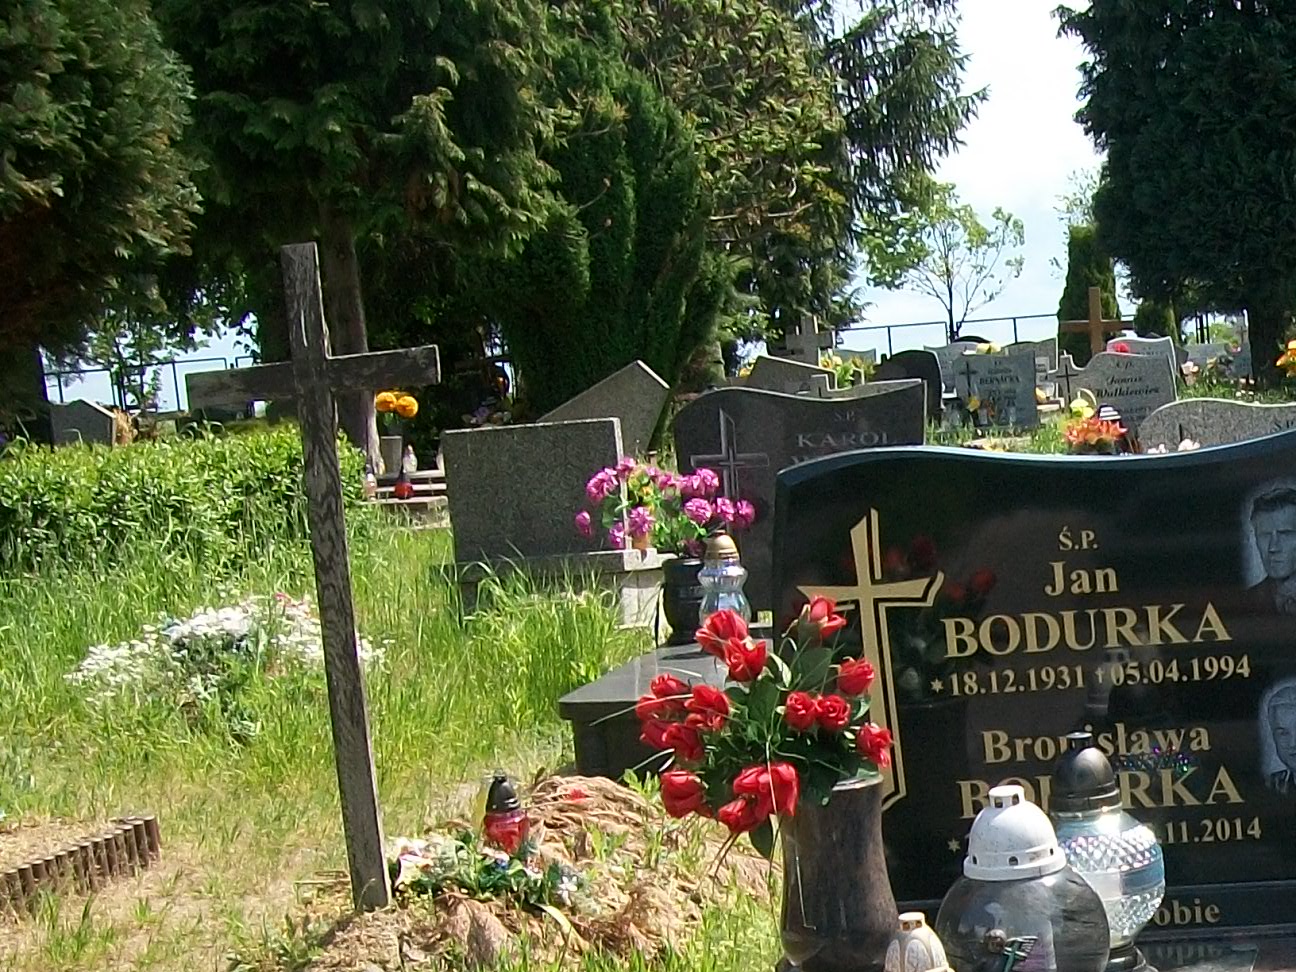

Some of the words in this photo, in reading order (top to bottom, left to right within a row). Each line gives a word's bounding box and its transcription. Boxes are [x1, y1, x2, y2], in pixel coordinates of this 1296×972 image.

[1058, 526, 1099, 551] Ś.P.
[1044, 560, 1120, 597] Jan
[941, 601, 1233, 659] BODURKA
[949, 664, 1085, 696] 18.12.1931
[1110, 653, 1251, 687] 05.04.1994
[981, 722, 1212, 765] Brosława
